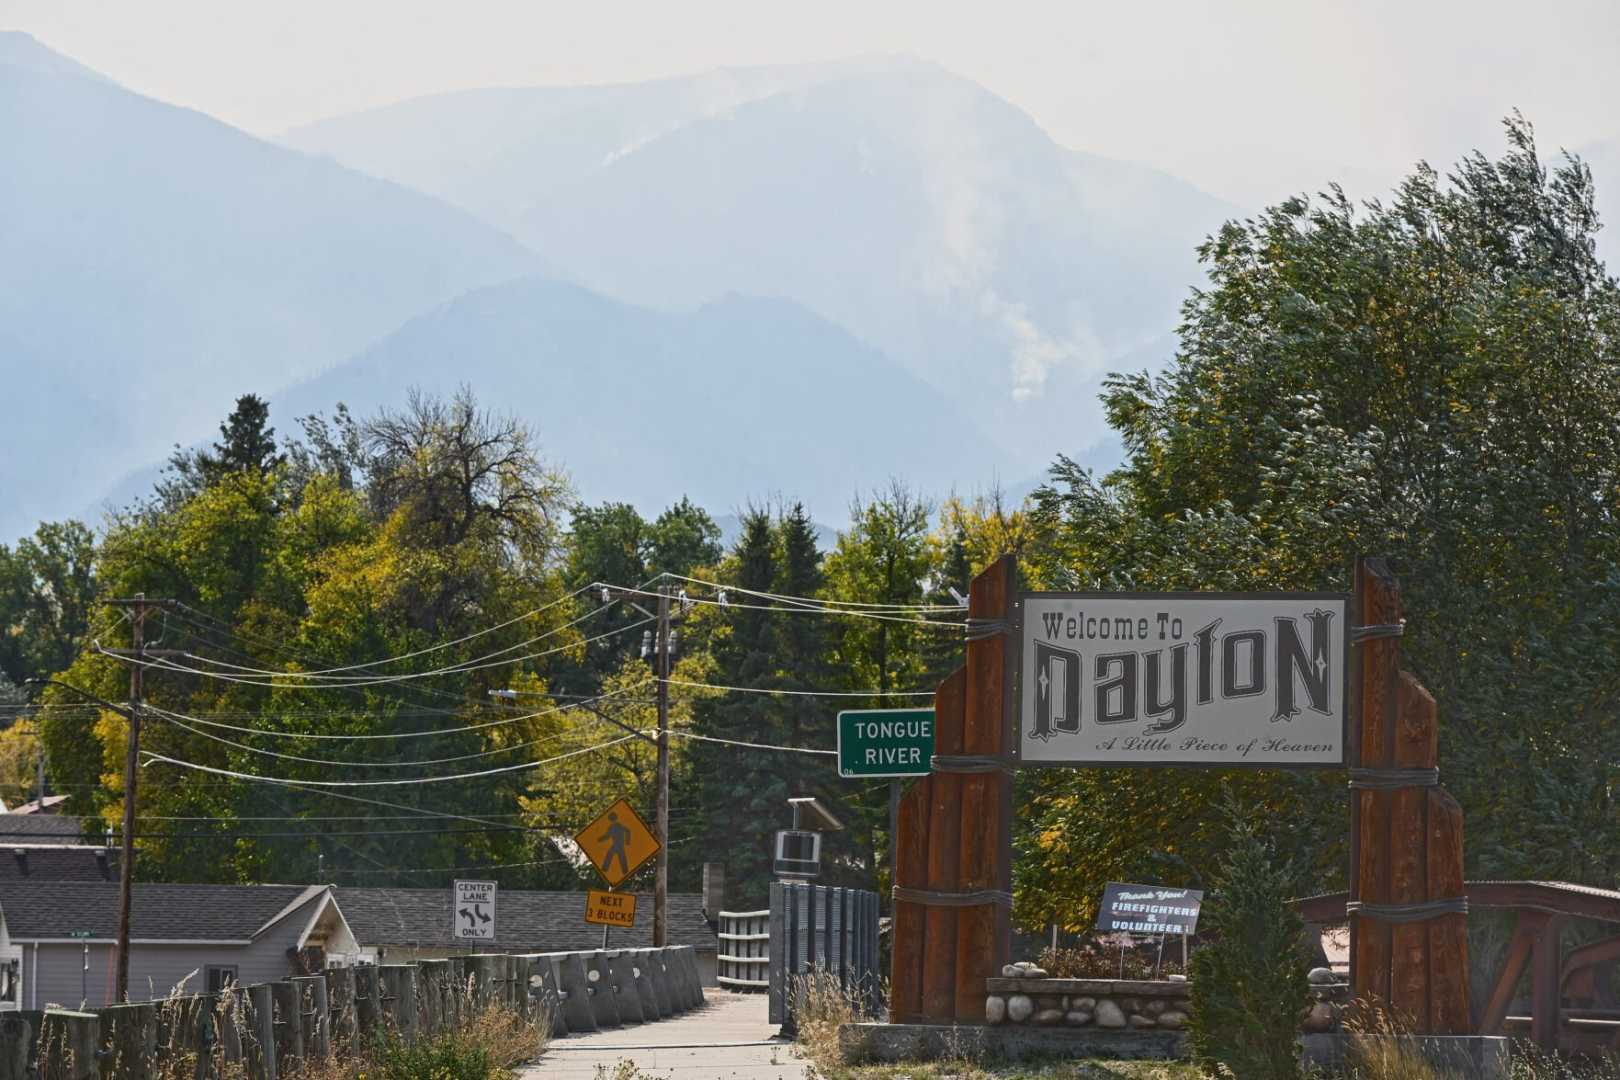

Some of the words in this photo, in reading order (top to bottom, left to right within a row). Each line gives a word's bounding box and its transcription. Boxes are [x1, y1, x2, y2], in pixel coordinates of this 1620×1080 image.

[1042, 611, 1149, 640] Welcome
[1156, 612, 1183, 640] To
[854, 721, 932, 738] TONGUE
[1095, 737, 1117, 751] A
[1121, 736, 1172, 752] Little
[1179, 737, 1228, 752] Piece
[1236, 738, 1258, 757] of
[1261, 738, 1333, 752] Heaven
[865, 747, 921, 765] RIVER
[458, 883, 494, 892] CENTER
[463, 892, 488, 901] LANE
[600, 895, 623, 907] NEXT
[596, 909, 633, 922] BLOCKS
[1111, 902, 1198, 917] FIREFIGHTERS
[1146, 914, 1157, 922] &
[462, 928, 487, 937] ONLY
